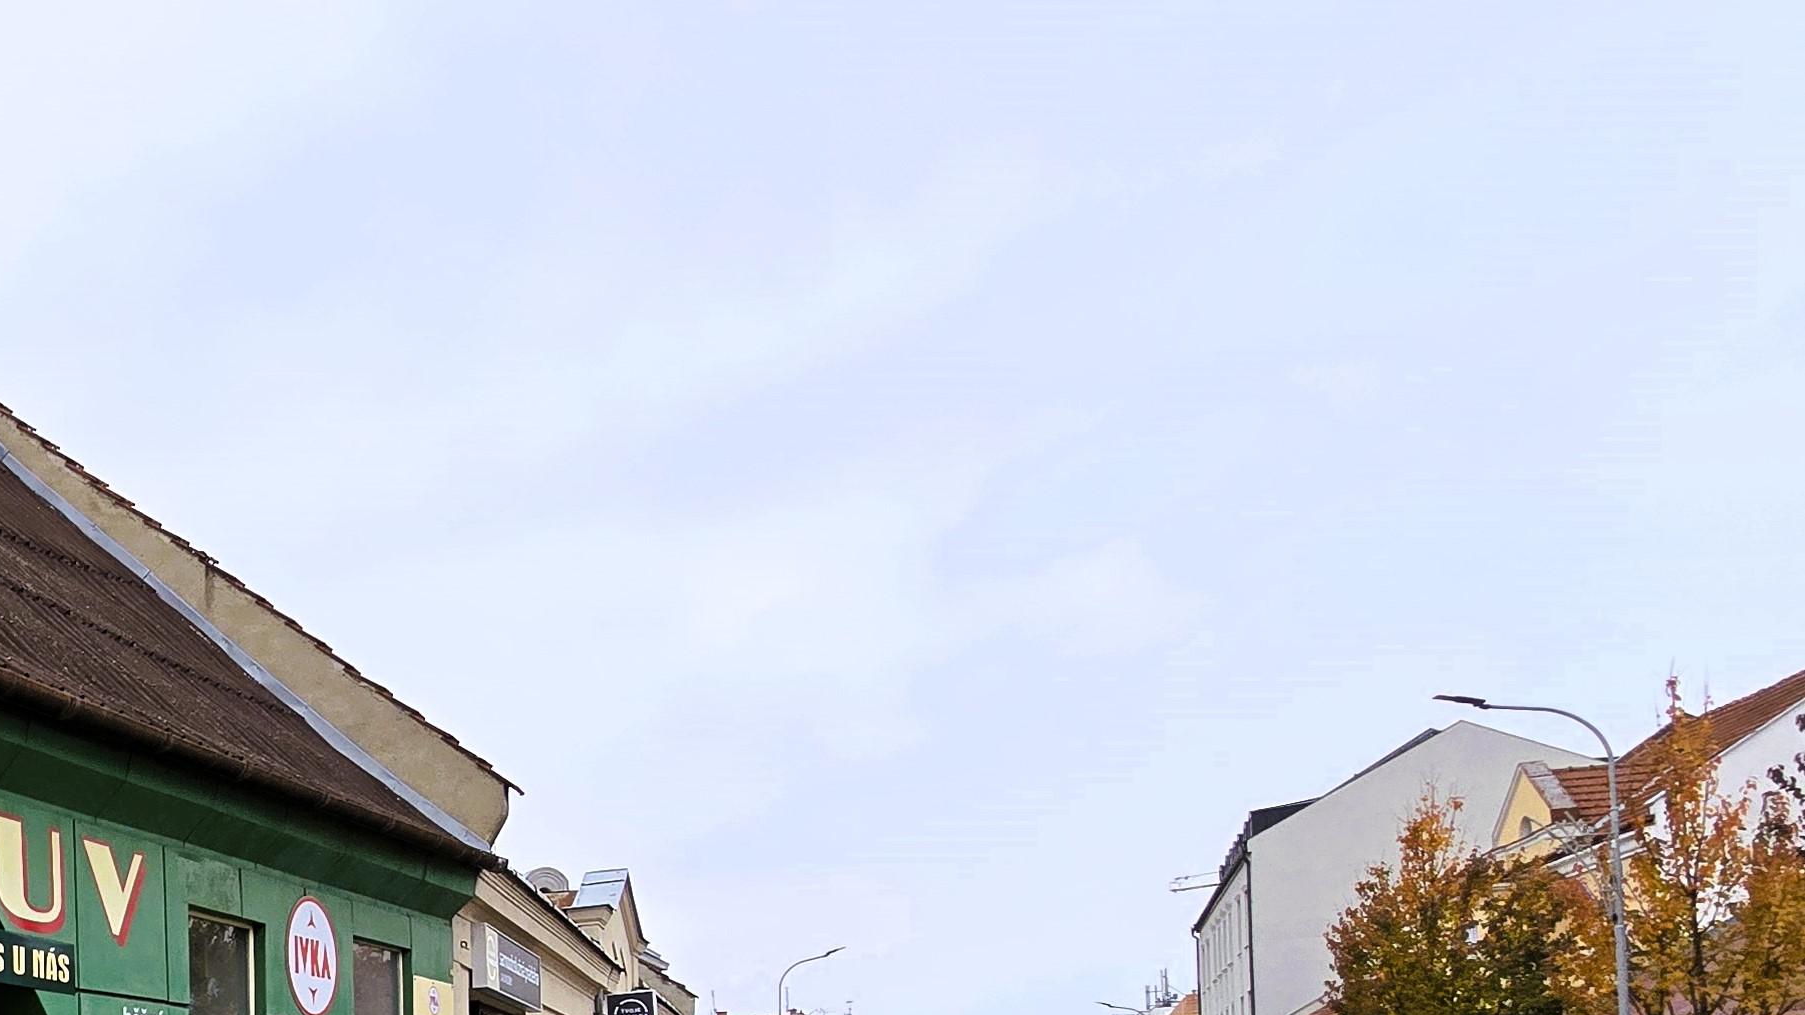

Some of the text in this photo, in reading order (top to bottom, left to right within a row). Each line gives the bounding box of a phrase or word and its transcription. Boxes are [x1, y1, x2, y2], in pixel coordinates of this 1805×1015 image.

[12, 944, 26, 975] U
[32, 947, 70, 983] NÁS
[294, 935, 331, 980] IVKA
